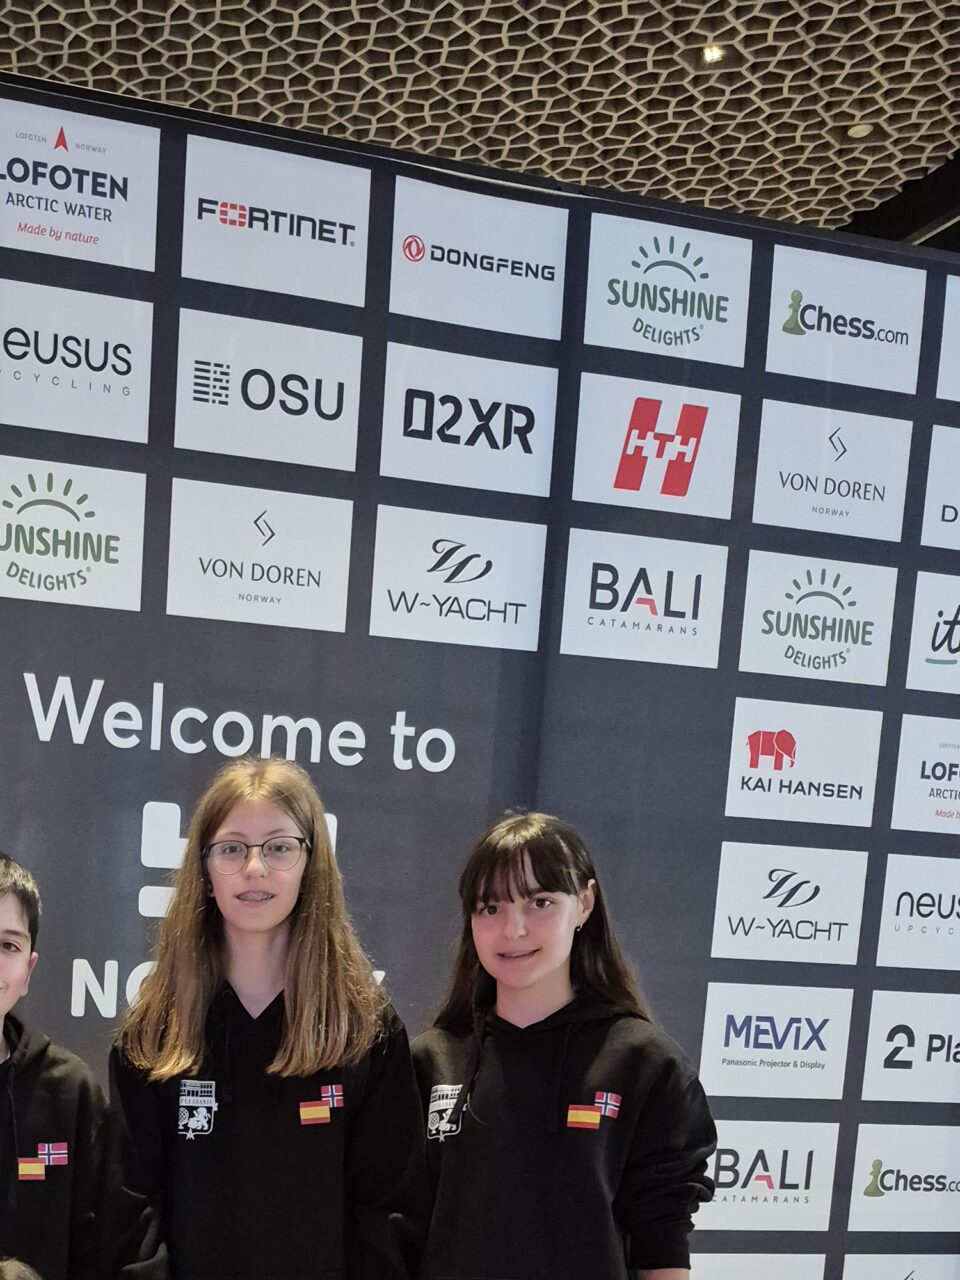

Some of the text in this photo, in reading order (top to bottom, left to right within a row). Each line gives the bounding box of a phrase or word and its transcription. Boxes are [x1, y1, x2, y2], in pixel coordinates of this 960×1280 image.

[6, 192, 112, 223] ARCTIC WATER
[17, 222, 99, 245] Made by nature
[430, 244, 555, 281] DONGFENG
[607, 278, 729, 323] SUNSHINE
[633, 317, 700, 346] DELIGHTS
[799, 304, 908, 346] Chess.com
[241, 369, 344, 421] OSU
[779, 471, 885, 502] VON DOREN
[812, 506, 850, 517] NORWAY
[6, 561, 87, 591] DELIGHTS
[199, 557, 321, 588] VON DOREN
[238, 593, 282, 603] NORWAY
[589, 562, 702, 620] BALI
[588, 617, 698, 635] CATAMARANS
[761, 610, 874, 646] SUNSHINE
[784, 645, 847, 670] DELIGHTS
[23, 673, 456, 773] Welcome to
[741, 776, 862, 800] KAI HANSEN
[883, 1024, 915, 1069] 2
[722, 1058, 757, 1067] Panasonic
[759, 1059, 791, 1069] Projector
[800, 1062, 825, 1070] Display
[713, 1149, 814, 1190] BALI
